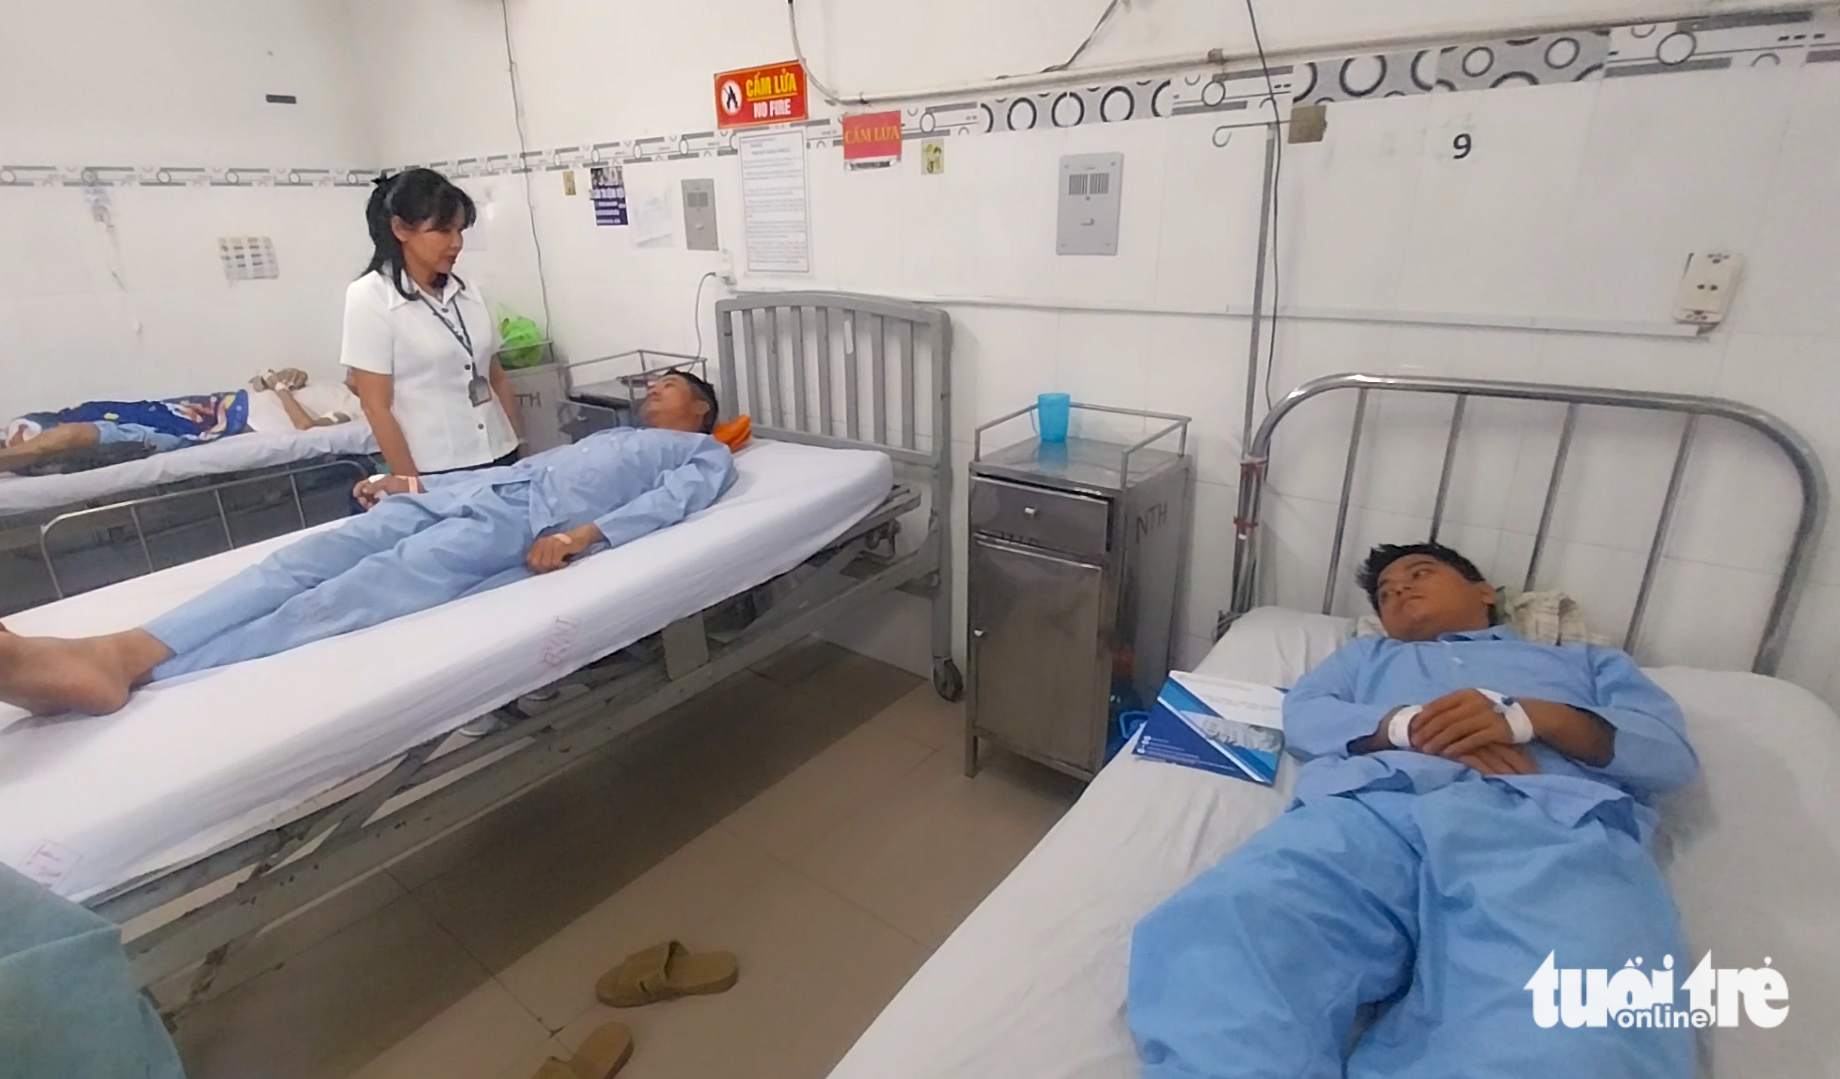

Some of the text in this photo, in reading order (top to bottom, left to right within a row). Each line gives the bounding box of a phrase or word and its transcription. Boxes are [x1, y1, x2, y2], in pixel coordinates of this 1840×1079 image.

[745, 68, 797, 97] CẤM LỬA
[753, 98, 791, 119] NO FIRE
[1453, 133, 1471, 159] 9
[1136, 500, 1168, 544] NTH
